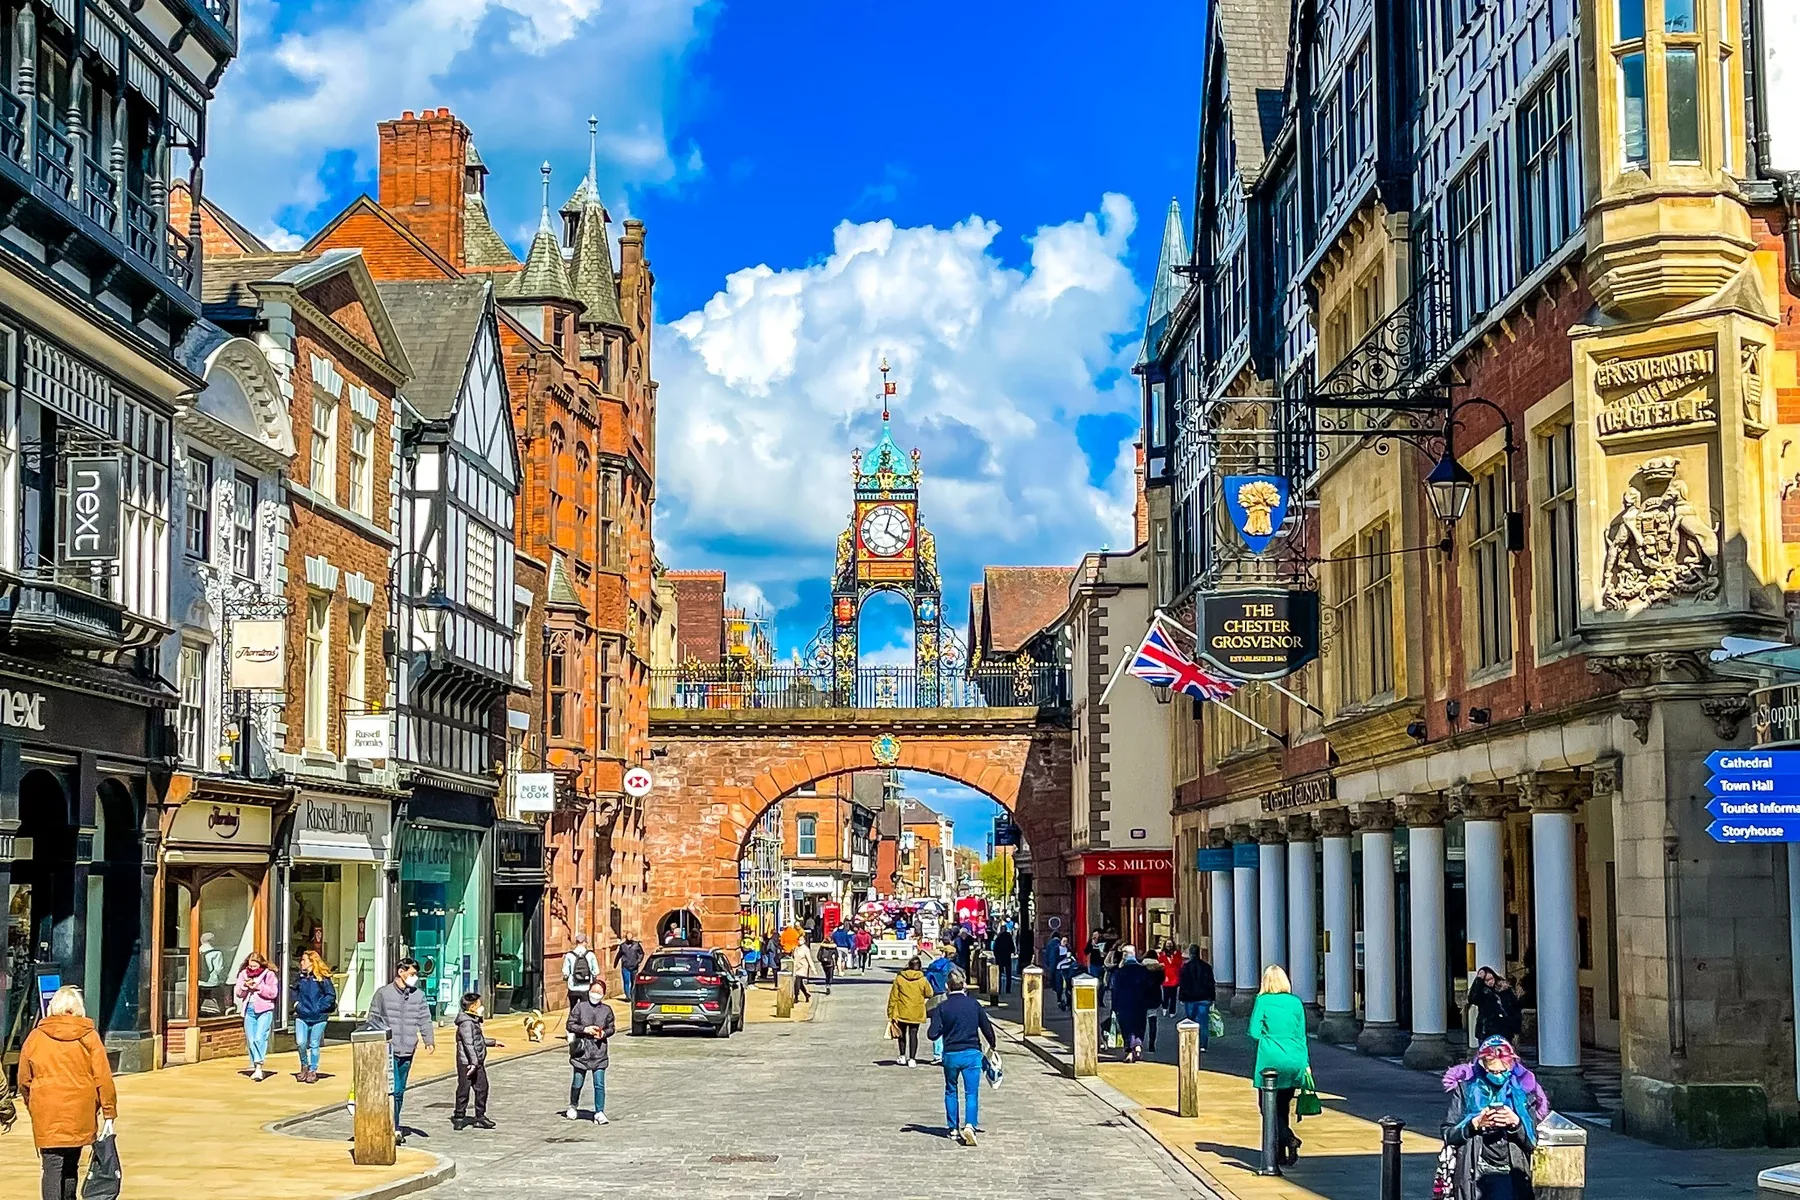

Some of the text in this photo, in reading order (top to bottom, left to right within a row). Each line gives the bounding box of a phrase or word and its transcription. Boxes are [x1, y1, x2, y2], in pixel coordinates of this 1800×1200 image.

[75, 470, 101, 551] next
[1242, 604, 1274, 617] THE
[1223, 620, 1290, 633] CHESTER
[1212, 636, 1303, 649] GROSVENOR
[0, 688, 46, 731] next
[1760, 698, 1800, 729] Shoppi
[355, 730, 381, 738] Russell
[1720, 757, 1773, 769] Cathedral
[1720, 780, 1773, 792] Town Hall
[1720, 802, 1758, 814] Tourist
[306, 799, 374, 839] Russell Bromley
[1722, 825, 1784, 839] Storyhouse
[428, 848, 450, 864] LOOK
[1123, 859, 1173, 870] MILTON
